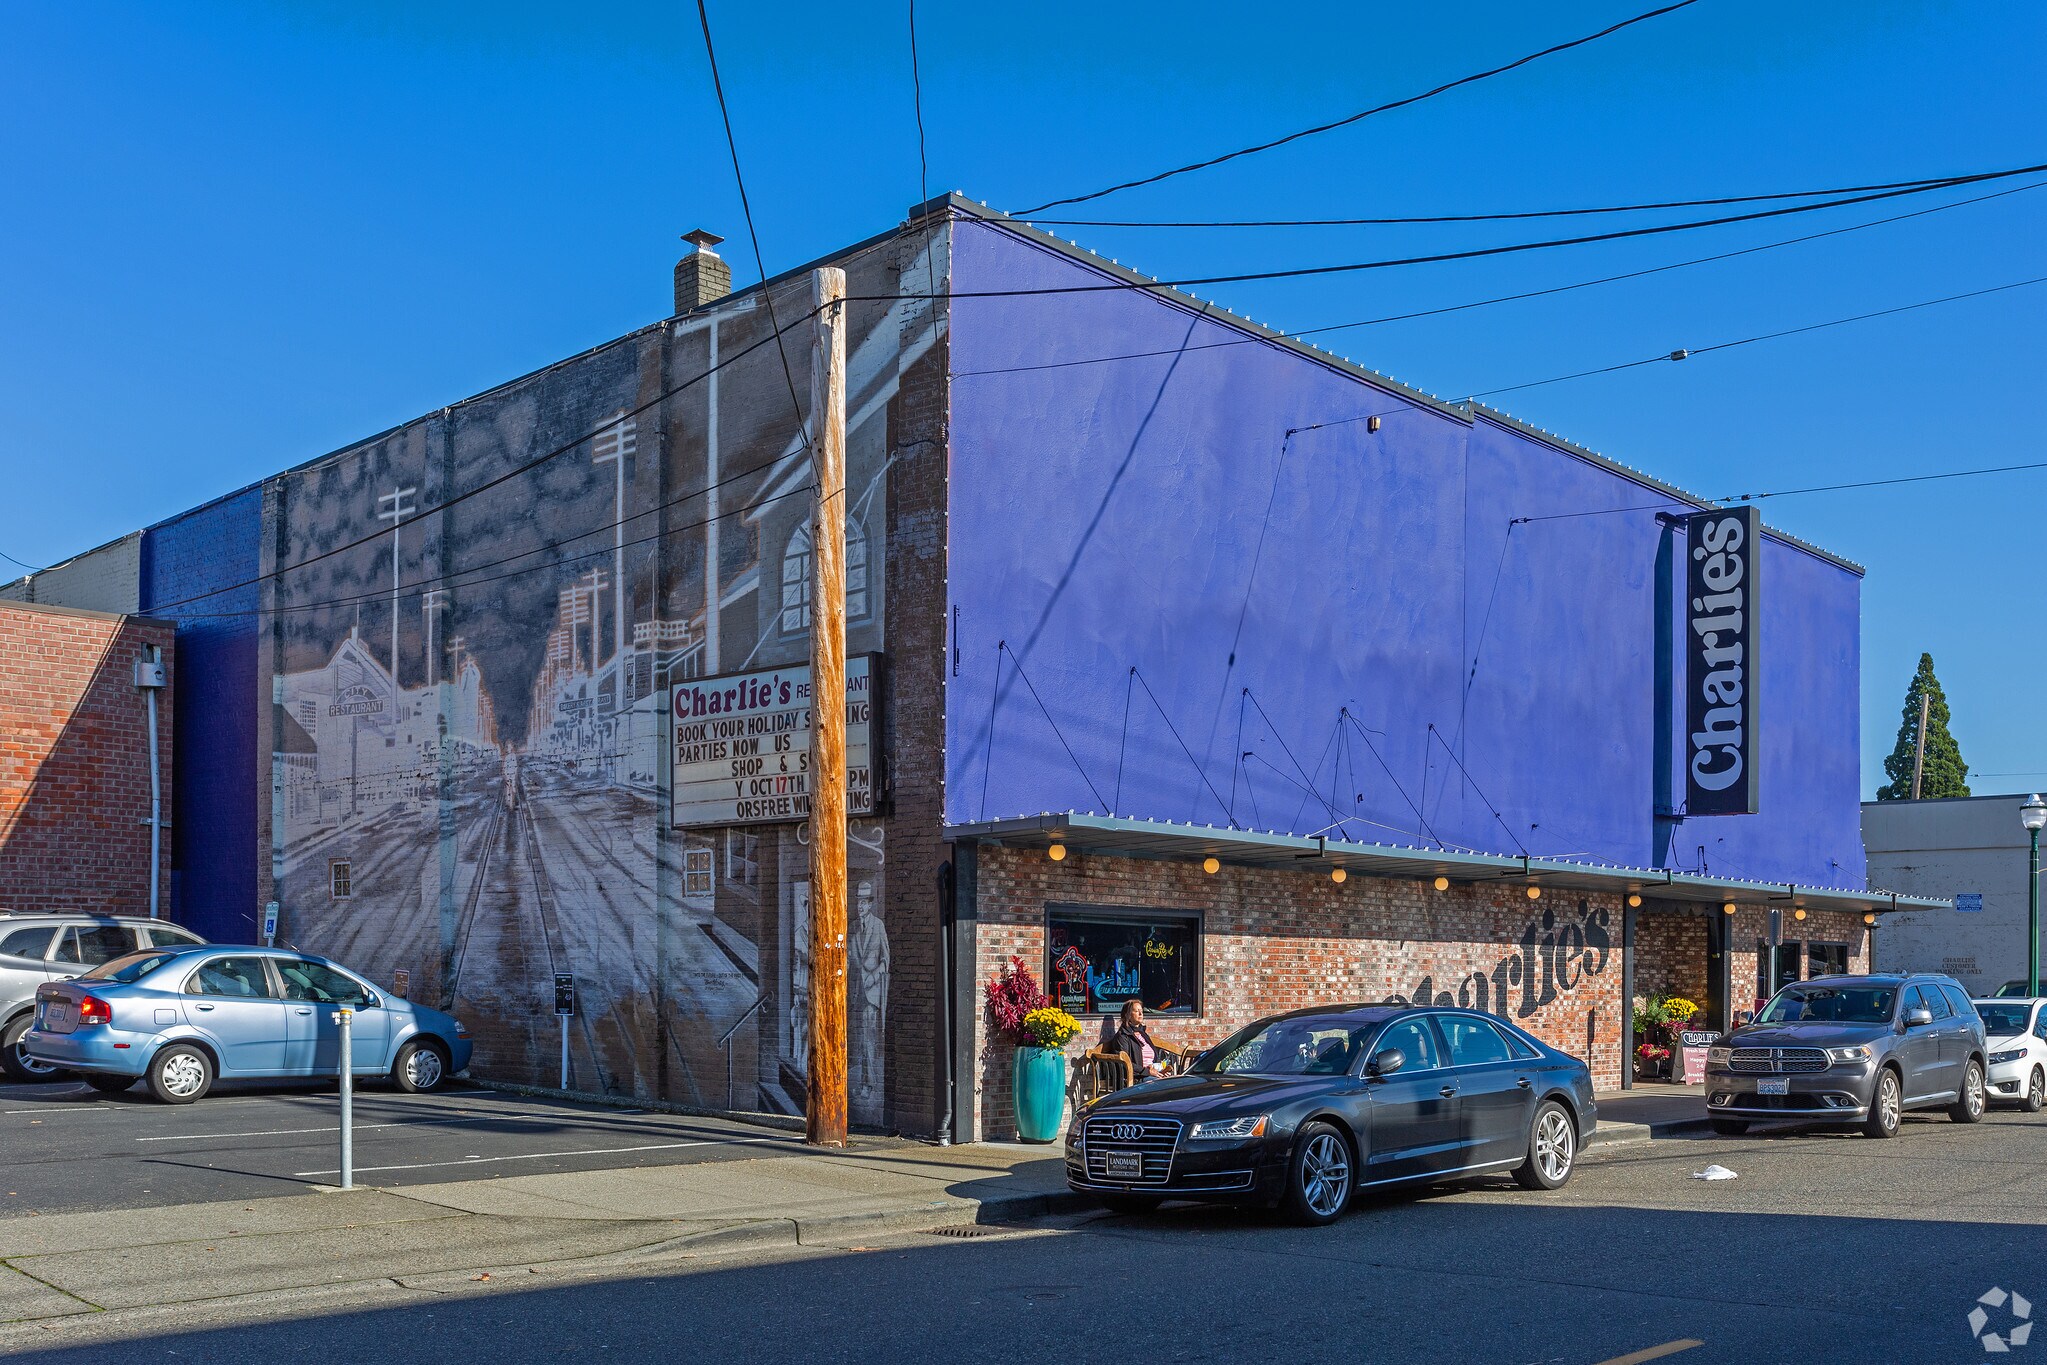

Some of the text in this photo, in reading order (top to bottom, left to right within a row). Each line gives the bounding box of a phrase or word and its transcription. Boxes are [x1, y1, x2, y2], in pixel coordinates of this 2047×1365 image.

[1692, 516, 1744, 792] Charlie's
[344, 686, 368, 699] CITY
[675, 675, 791, 719] Charlie's
[330, 700, 383, 716] RESTAURANT
[677, 723, 707, 744] BOOK
[712, 719, 744, 739] YOUR
[747, 711, 799, 735] HOLIDAY
[678, 733, 791, 762] PARTIES NOW US
[731, 757, 763, 777] SHOP
[779, 754, 788, 772] &
[735, 769, 869, 798] Y OCT 17TH PM
[1110, 1158, 1138, 1166] LANDMARK
